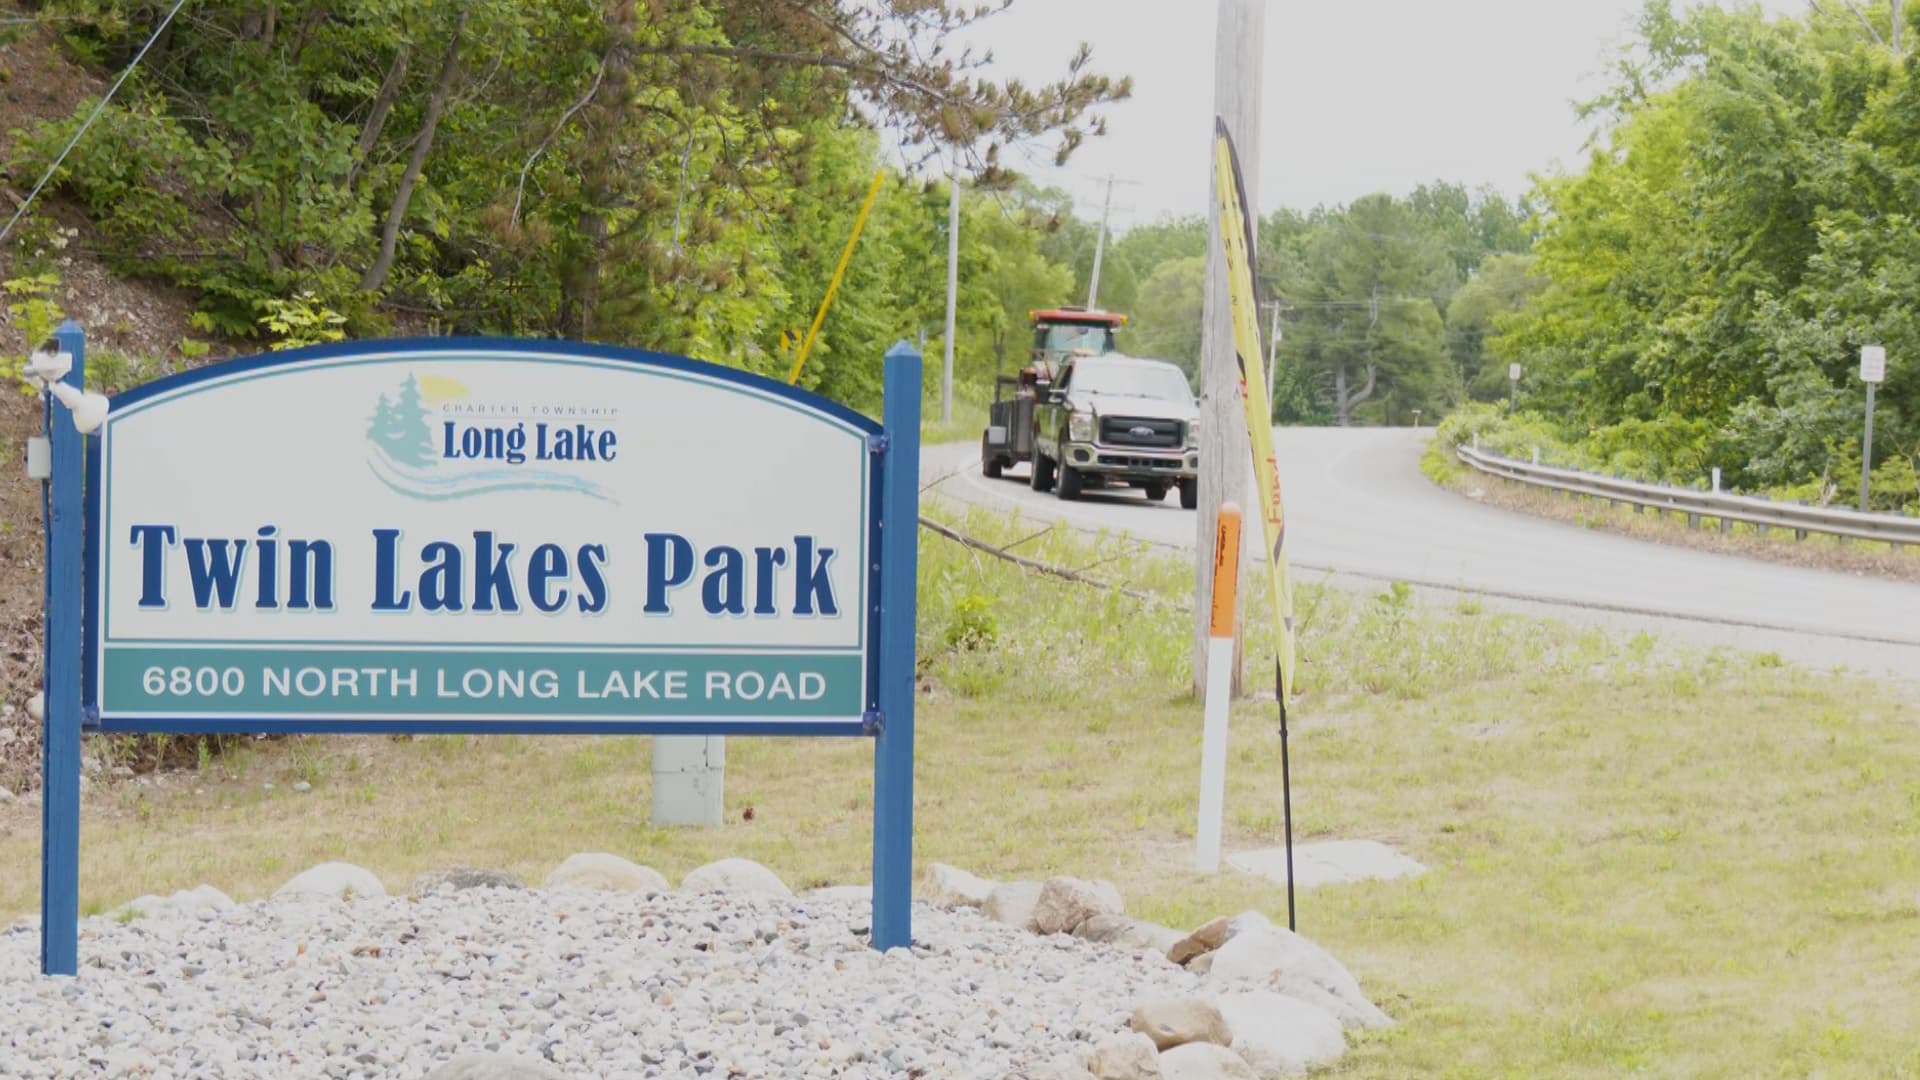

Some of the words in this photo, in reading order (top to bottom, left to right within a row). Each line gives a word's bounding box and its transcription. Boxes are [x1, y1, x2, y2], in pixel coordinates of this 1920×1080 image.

[442, 403, 519, 414] CHARTER
[531, 405, 618, 416] TOWNSHIP
[443, 421, 526, 464] Long
[536, 423, 617, 461] Lake
[130, 525, 333, 609] Twin
[371, 529, 606, 613] Lakes
[643, 533, 838, 616] Park
[142, 666, 245, 697] 6800
[262, 667, 418, 698] NORTH
[437, 668, 559, 699] LONG
[577, 670, 688, 699] LAKE
[705, 671, 826, 700] ROAD
